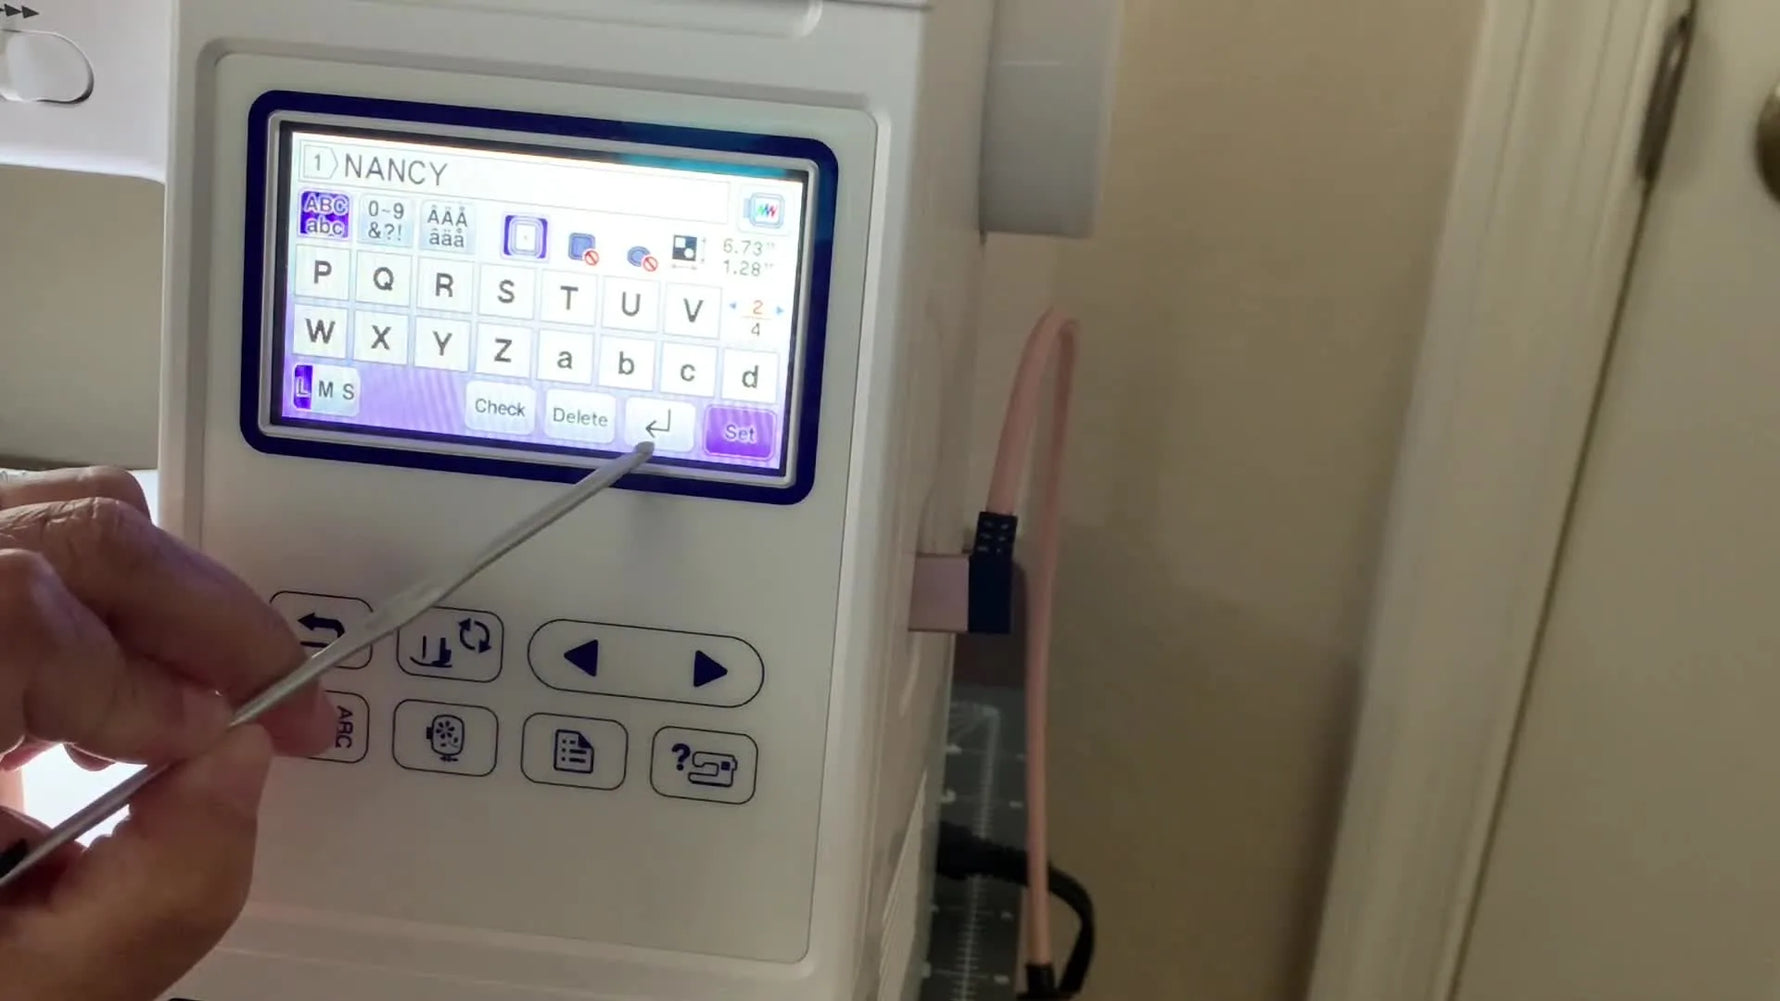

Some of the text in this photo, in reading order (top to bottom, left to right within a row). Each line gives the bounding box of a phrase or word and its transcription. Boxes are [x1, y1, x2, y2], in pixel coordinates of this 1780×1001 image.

[313, 154, 322, 171] 1
[344, 153, 448, 186] NANCY
[304, 193, 349, 215] ABC
[306, 217, 344, 236] abc
[367, 221, 402, 241] &?!
[313, 260, 704, 323] P Q R S T U V
[752, 300, 764, 315] 2
[751, 322, 760, 336] 4
[305, 318, 760, 389] W X Y Z a b c d
[296, 378, 355, 400] L M S
[475, 398, 526, 418] Check
[552, 407, 608, 427] Delete
[725, 424, 756, 442] Set
